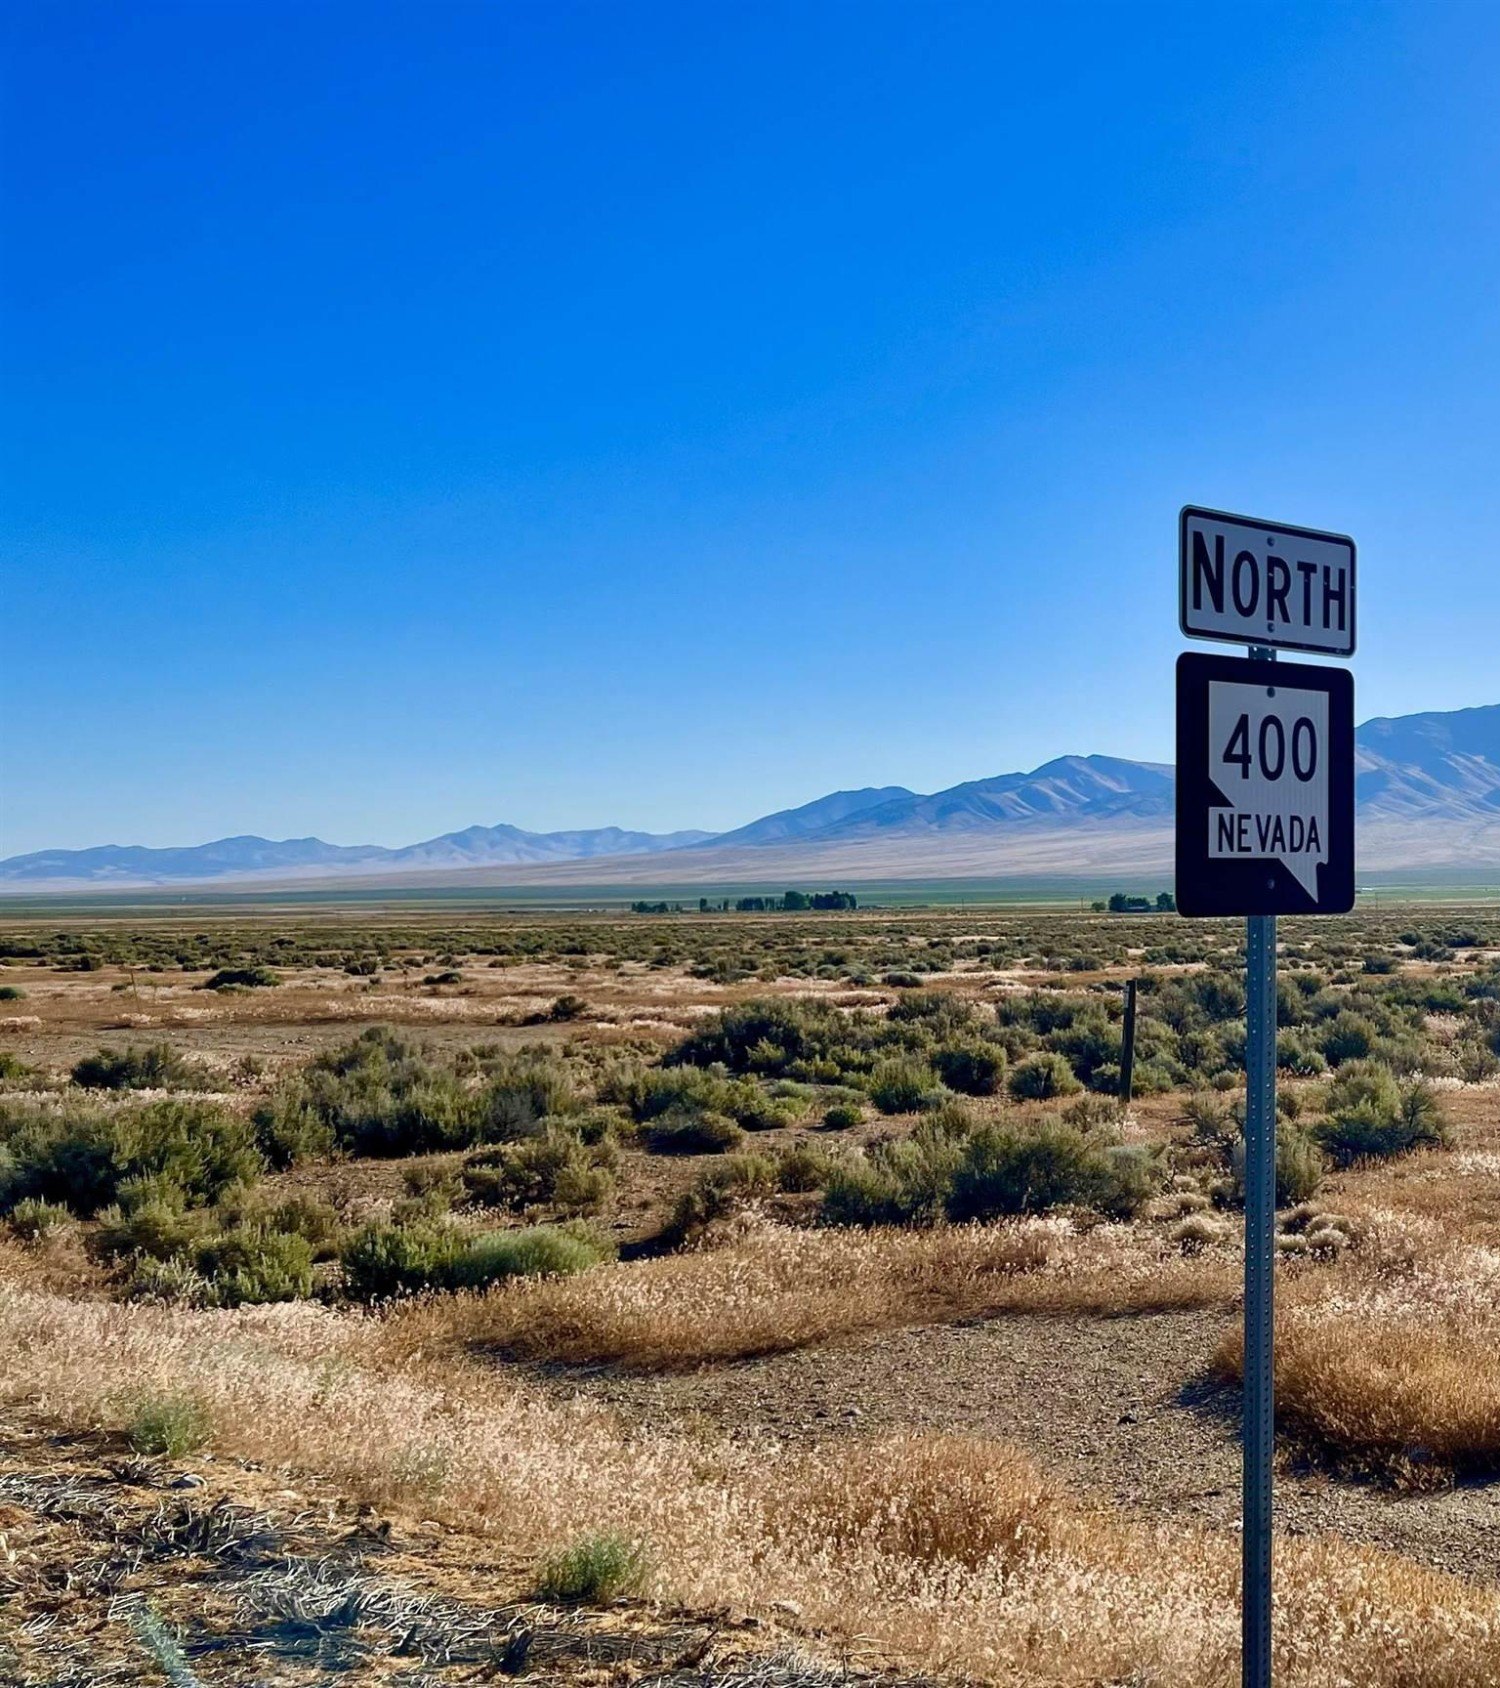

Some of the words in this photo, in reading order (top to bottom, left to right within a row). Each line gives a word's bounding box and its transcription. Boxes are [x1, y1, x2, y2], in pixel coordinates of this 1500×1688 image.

[1193, 531, 1346, 631] NORTH
[1223, 713, 1317, 782] 400
[1218, 813, 1321, 853] NEVADA
